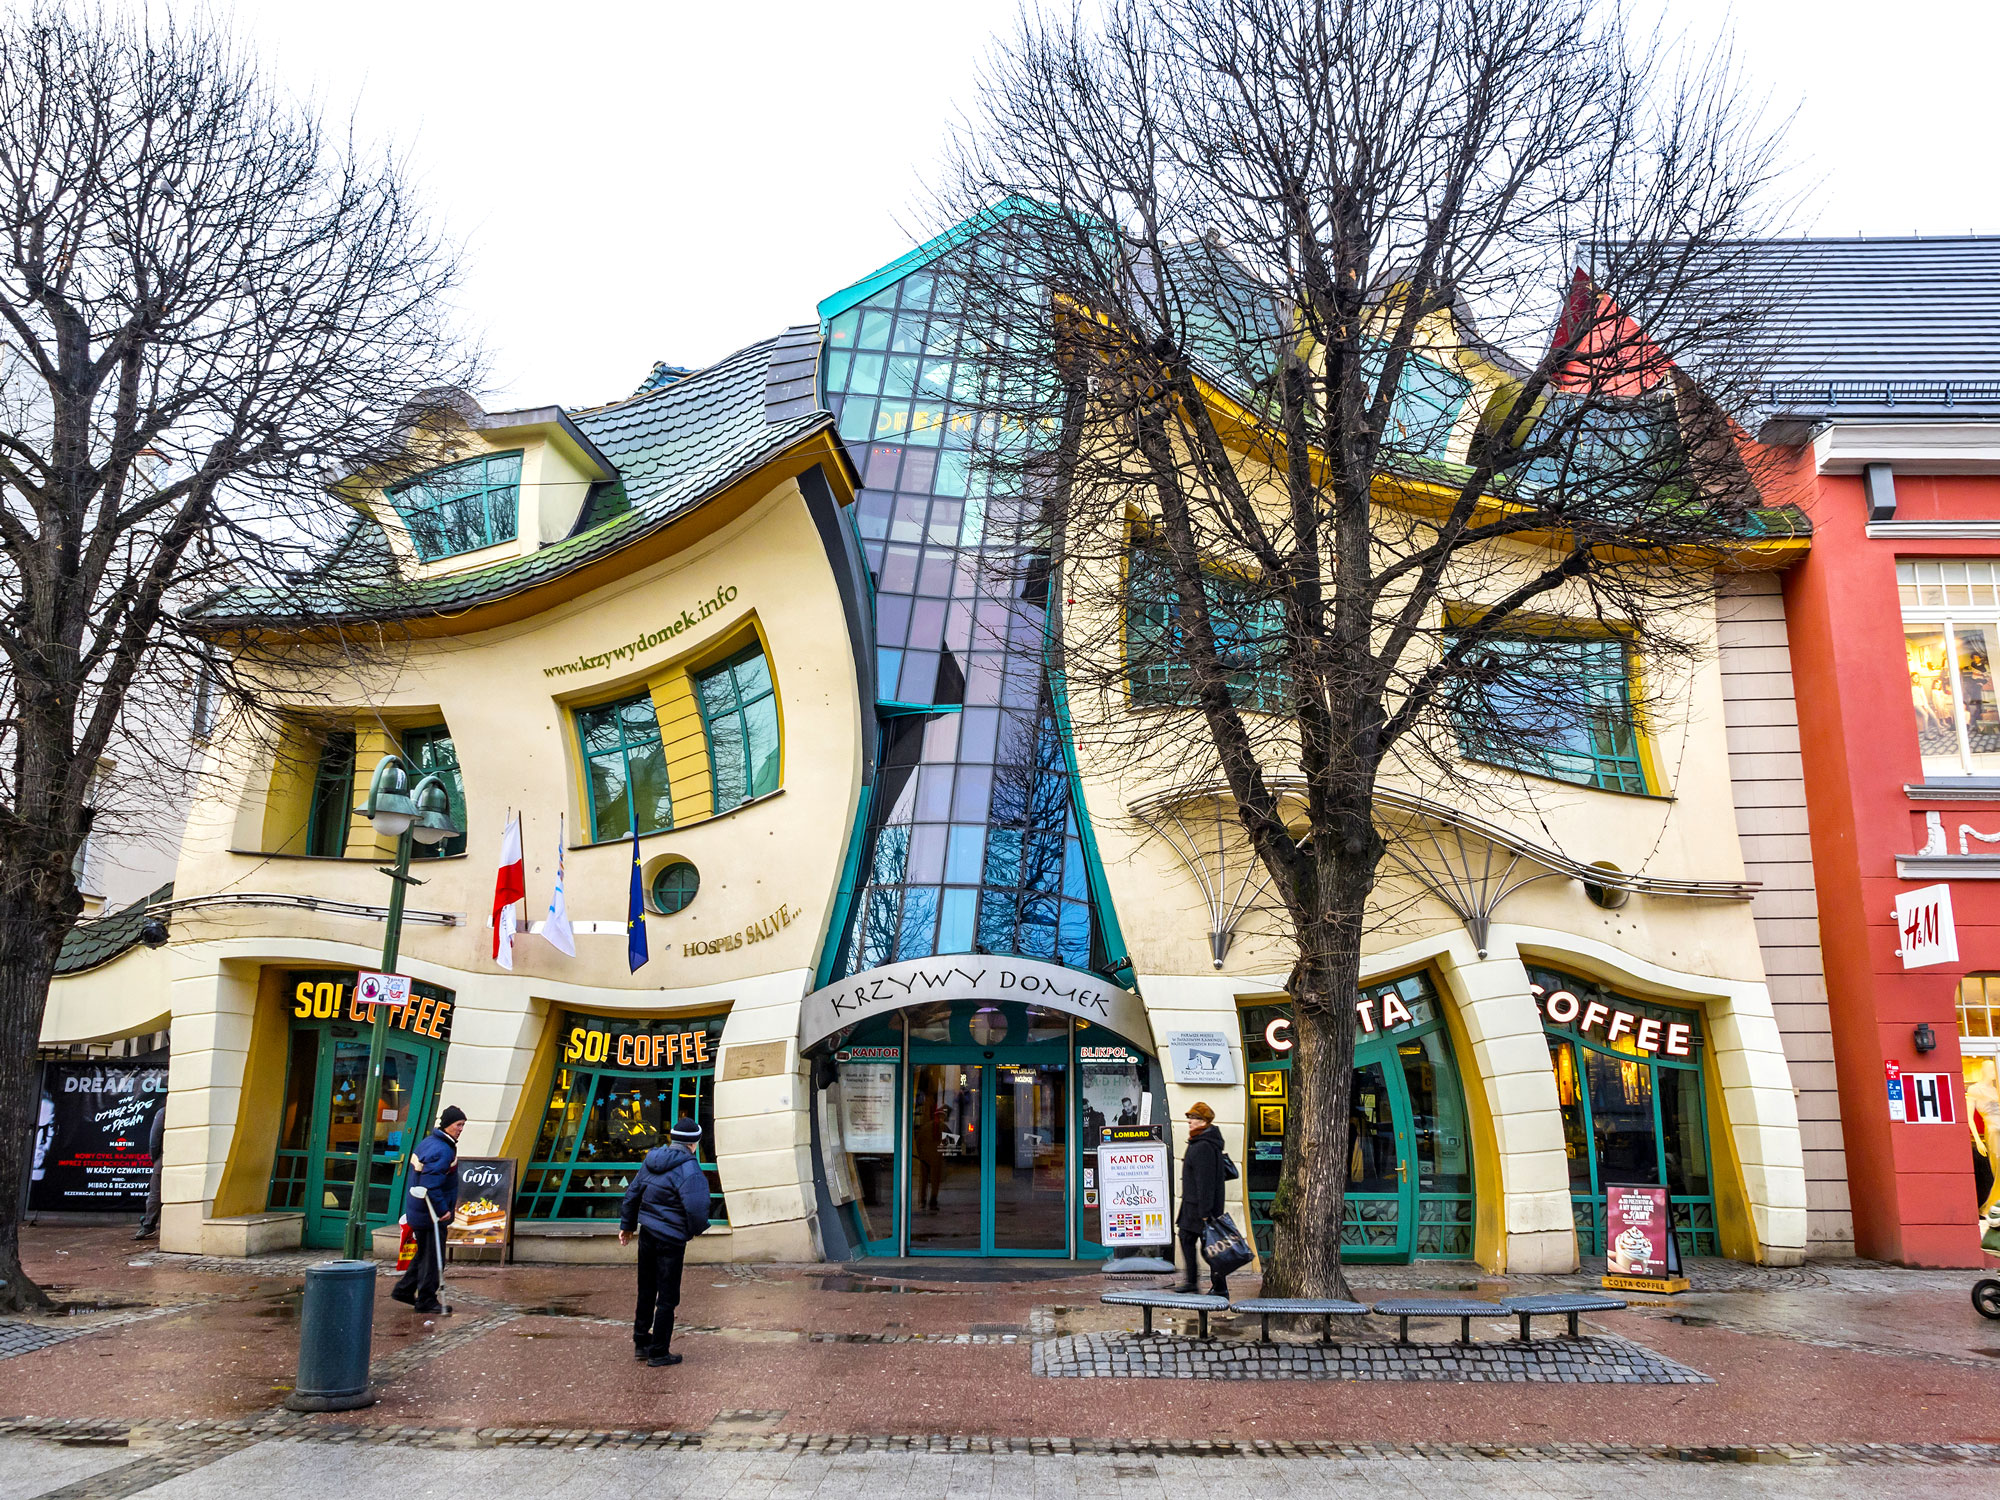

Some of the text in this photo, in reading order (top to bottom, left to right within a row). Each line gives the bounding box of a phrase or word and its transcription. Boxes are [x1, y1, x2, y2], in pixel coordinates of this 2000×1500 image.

[878, 412, 971, 432] DREAM
[543, 584, 738, 678] www.krzywydomek.info
[1904, 902, 1939, 951] H&M
[683, 932, 743, 958] HOSPES
[294, 981, 343, 1019] SO!
[831, 968, 1110, 1018] KRZYWY DOMEK
[1264, 992, 1413, 1051] CTA
[567, 1027, 611, 1063] SO!
[617, 1030, 709, 1067] COFFEE
[852, 1047, 900, 1058] KANTOR
[1080, 1046, 1128, 1058] BLIKPOL
[64, 1077, 135, 1093] DREAM
[118, 1095, 135, 1104] THE
[1915, 1079, 1939, 1118] H
[95, 1105, 127, 1122] OTHER
[111, 1114, 144, 1133] DREAM
[1110, 1154, 1154, 1164] KANTOR
[93, 1166, 116, 1174] KAŻDY
[462, 1168, 502, 1186] Gofry
[1608, 1279, 1665, 1290] COSTA COFFEE
